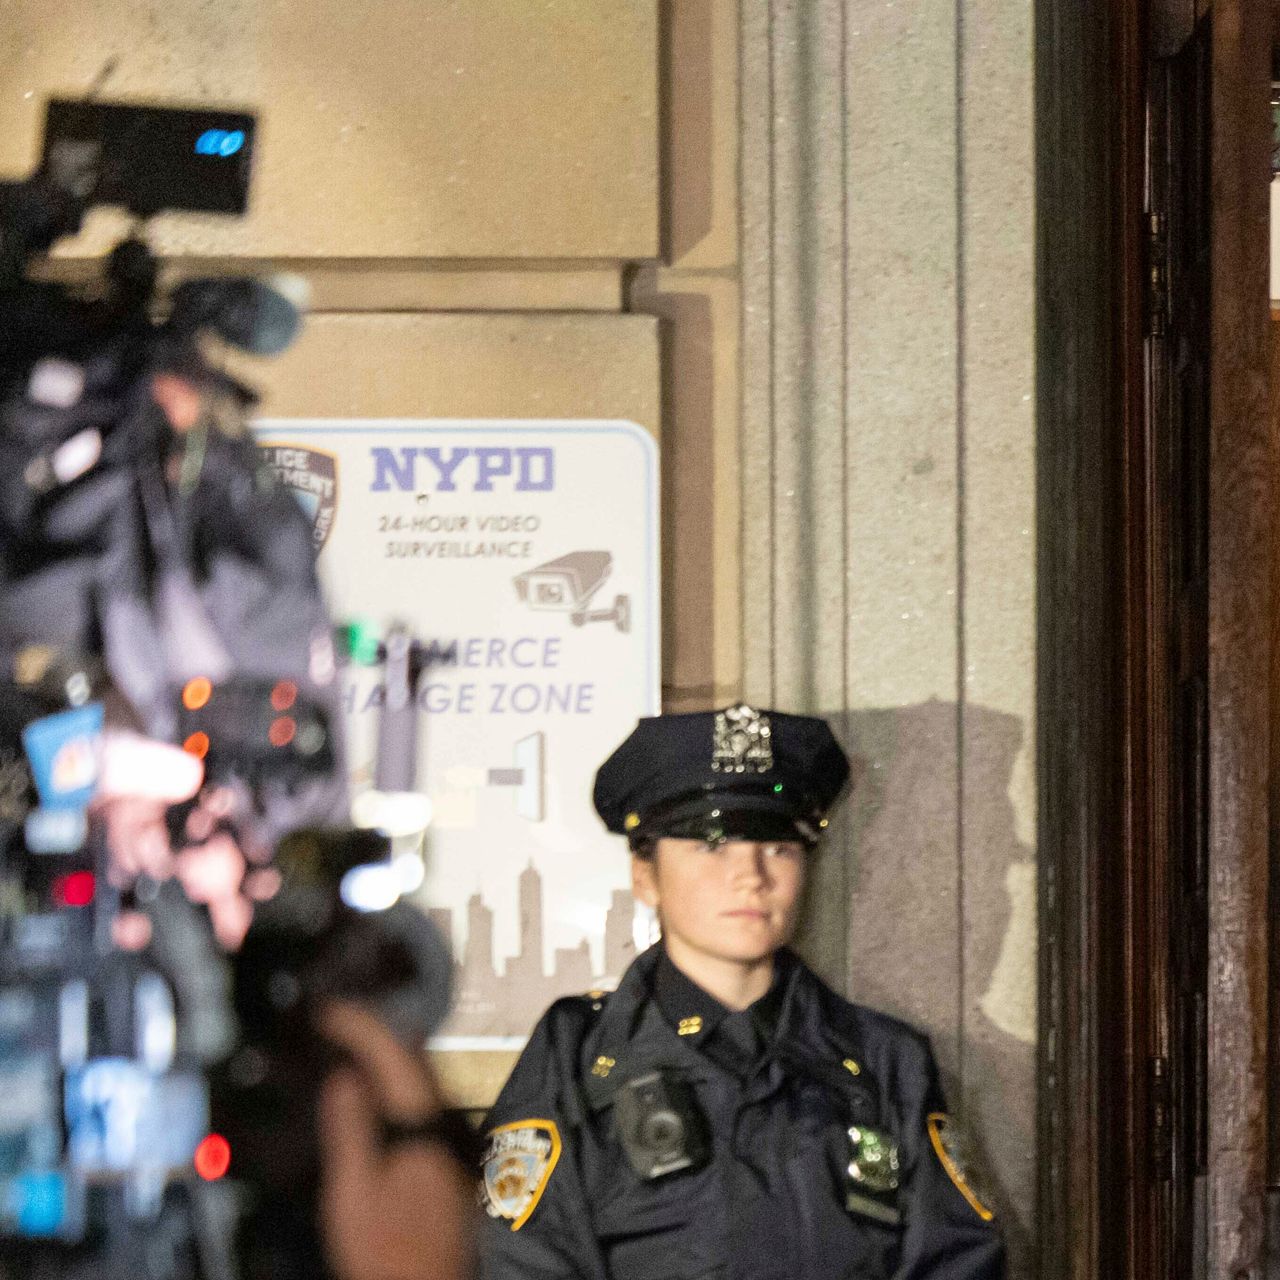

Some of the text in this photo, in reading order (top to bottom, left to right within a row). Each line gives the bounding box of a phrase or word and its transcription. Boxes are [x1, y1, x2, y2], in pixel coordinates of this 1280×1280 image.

[370, 446, 554, 492] NYPD
[378, 515, 541, 533] 24-HOUR VIDEO
[385, 541, 534, 559] SURVEILLANCE
[489, 683, 595, 714] ZONE
